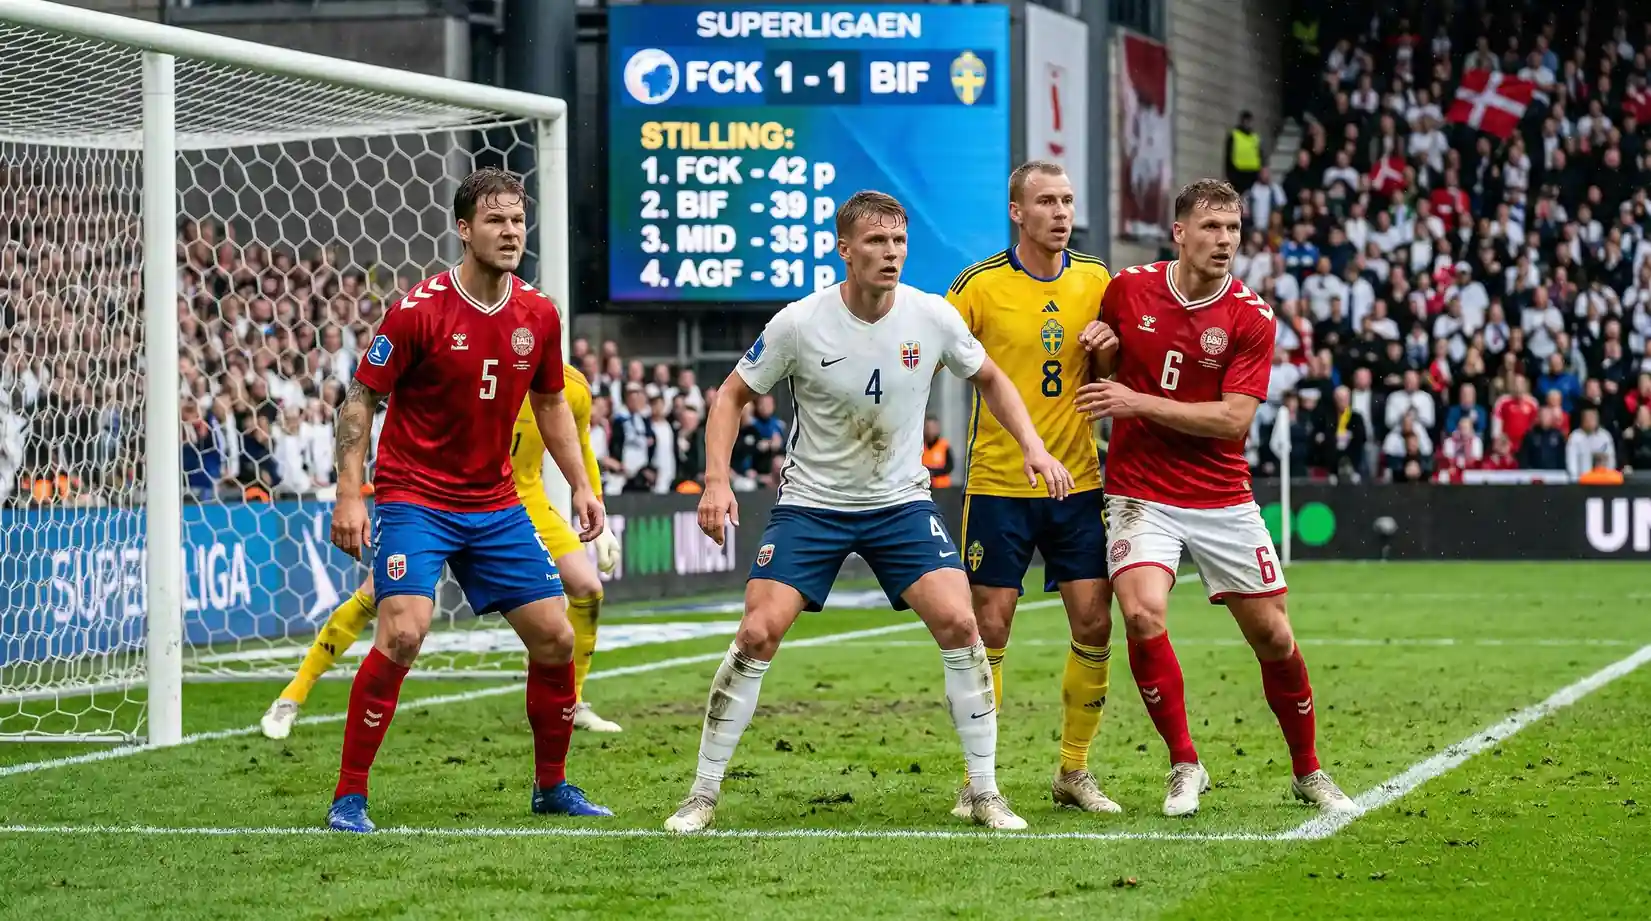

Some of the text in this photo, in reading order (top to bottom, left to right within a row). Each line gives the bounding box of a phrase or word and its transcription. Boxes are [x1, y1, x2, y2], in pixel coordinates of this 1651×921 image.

[696, 11, 921, 38] SUPERLIGAEN
[686, 61, 930, 93] FCK 1 - 1 BIF
[640, 122, 794, 150] STILLING:
[641, 156, 669, 184] 1.
[676, 156, 743, 184] FCK
[768, 156, 807, 184] 42
[813, 162, 836, 189] p
[640, 190, 669, 219] 2.
[676, 190, 729, 219] BIF
[769, 190, 808, 219] 39
[813, 197, 835, 224] p
[640, 224, 669, 253] 3.
[676, 224, 737, 253] MID
[769, 224, 808, 253] 35
[813, 231, 835, 258] p
[640, 258, 669, 288] 4.
[674, 258, 744, 288] AGF
[769, 259, 804, 287] 31
[814, 265, 836, 290] p
[479, 359, 499, 400] 5
[864, 368, 884, 405] 4
[1041, 359, 1063, 398] 8
[1160, 349, 1184, 391] 6
[929, 515, 949, 544] 4
[1255, 545, 1277, 585] 6
